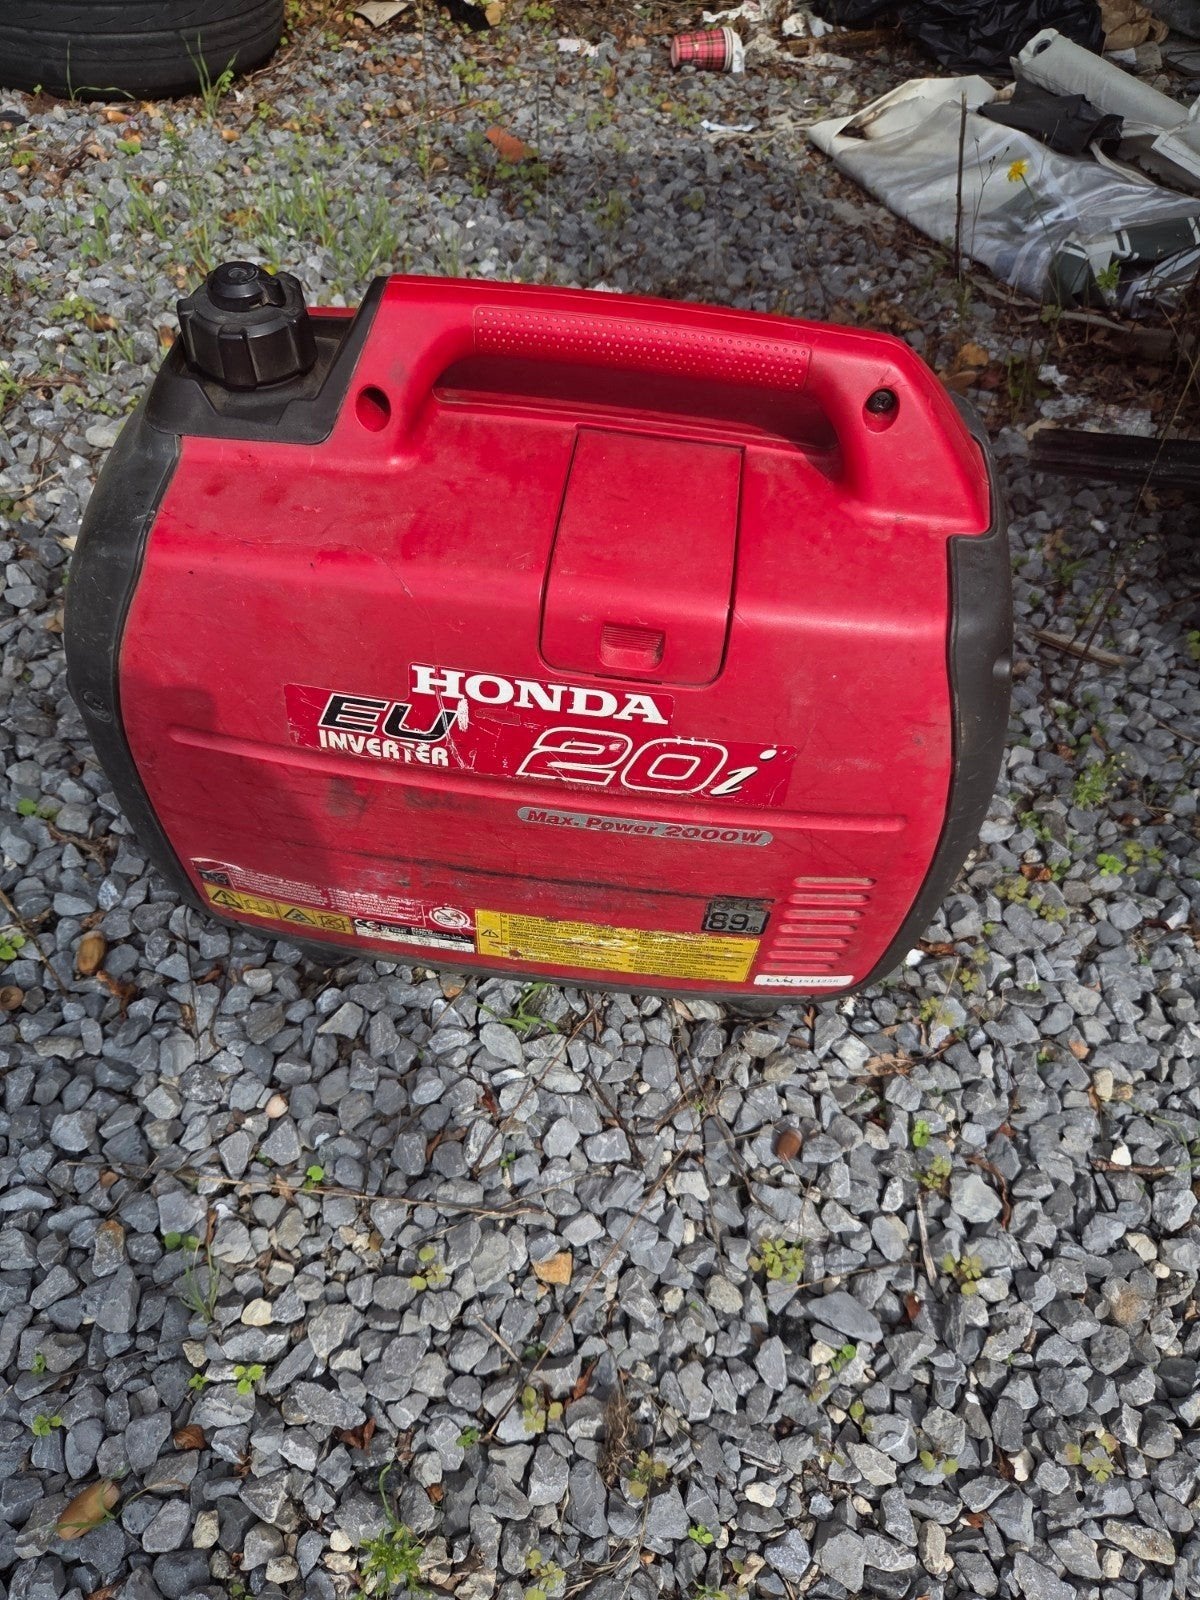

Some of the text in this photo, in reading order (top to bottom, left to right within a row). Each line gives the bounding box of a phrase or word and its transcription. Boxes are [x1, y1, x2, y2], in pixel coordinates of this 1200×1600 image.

[411, 665, 669, 725] HONDA
[318, 692, 777, 796] EU 20i
[318, 729, 449, 767] INVERTER
[526, 810, 763, 844] Max. Power 2000W
